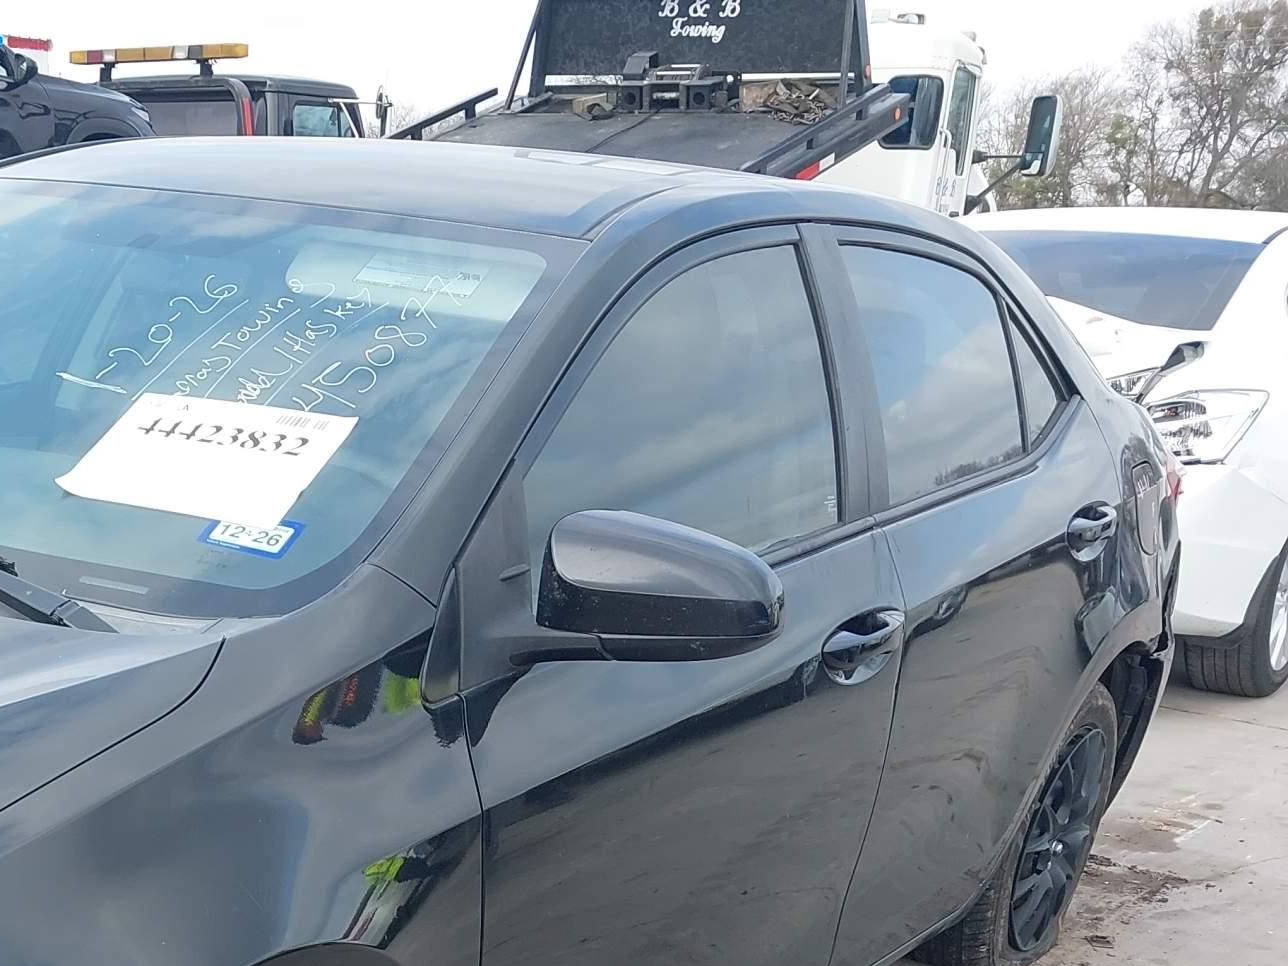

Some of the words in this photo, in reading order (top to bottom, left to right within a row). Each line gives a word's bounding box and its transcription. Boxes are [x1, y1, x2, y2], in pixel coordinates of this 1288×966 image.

[658, 0, 679, 17] B
[688, 0, 710, 17] &
[718, 0, 741, 17] B
[670, 17, 726, 43] Towing
[210, 278, 337, 351] Towing
[137, 417, 310, 457] 44423832
